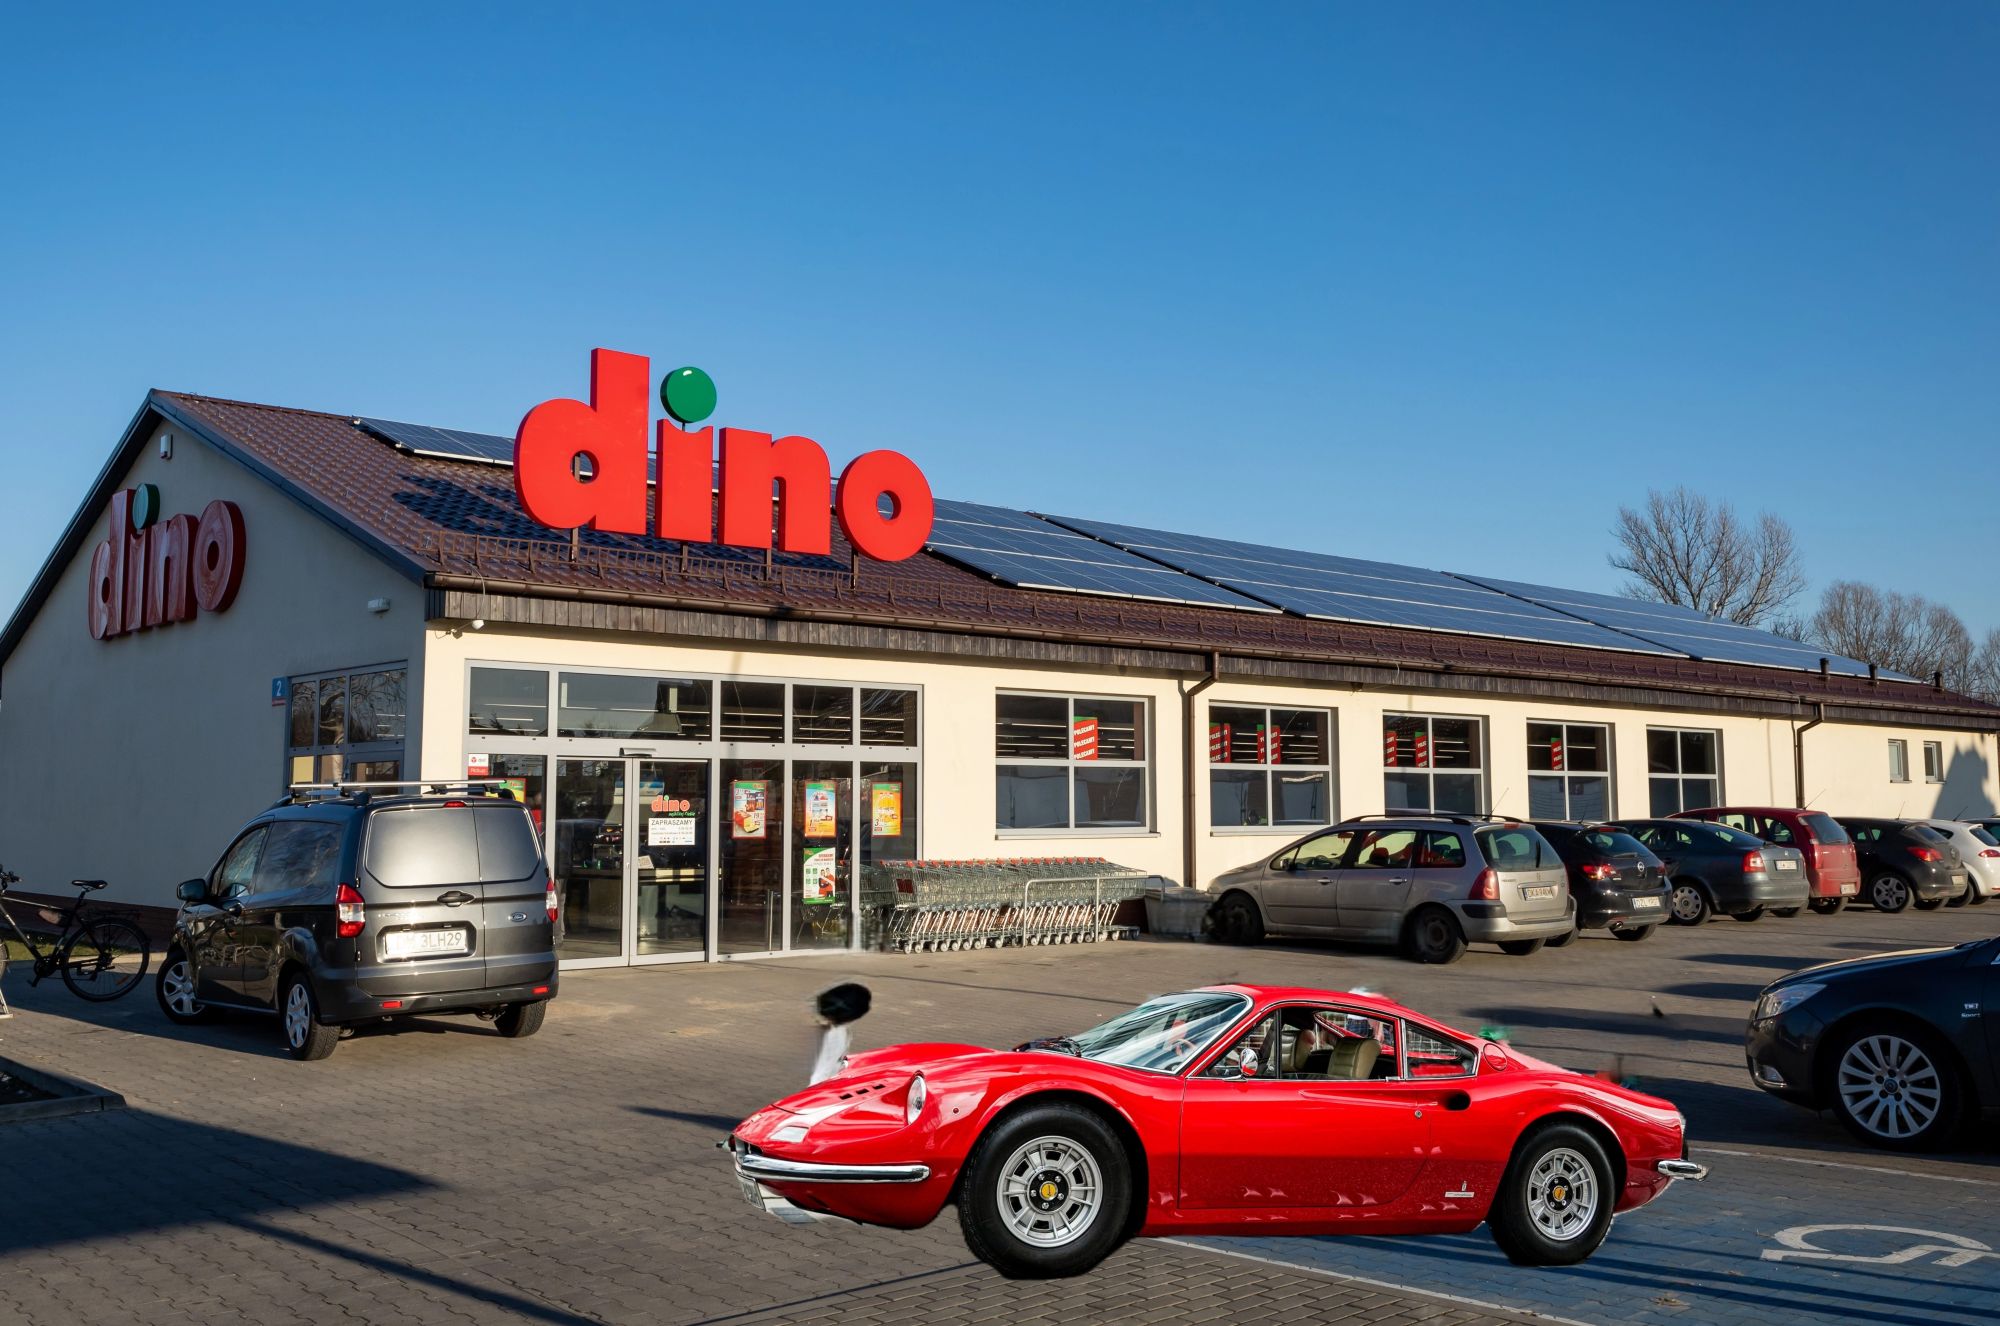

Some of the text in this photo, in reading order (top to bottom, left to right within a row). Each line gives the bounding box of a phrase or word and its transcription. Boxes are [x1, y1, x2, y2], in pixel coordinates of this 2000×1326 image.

[513, 348, 934, 562] dino
[88, 483, 247, 640] dino
[276, 680, 281, 696] 2
[651, 795, 690, 812] dino
[421, 931, 462, 948] 3LH29
